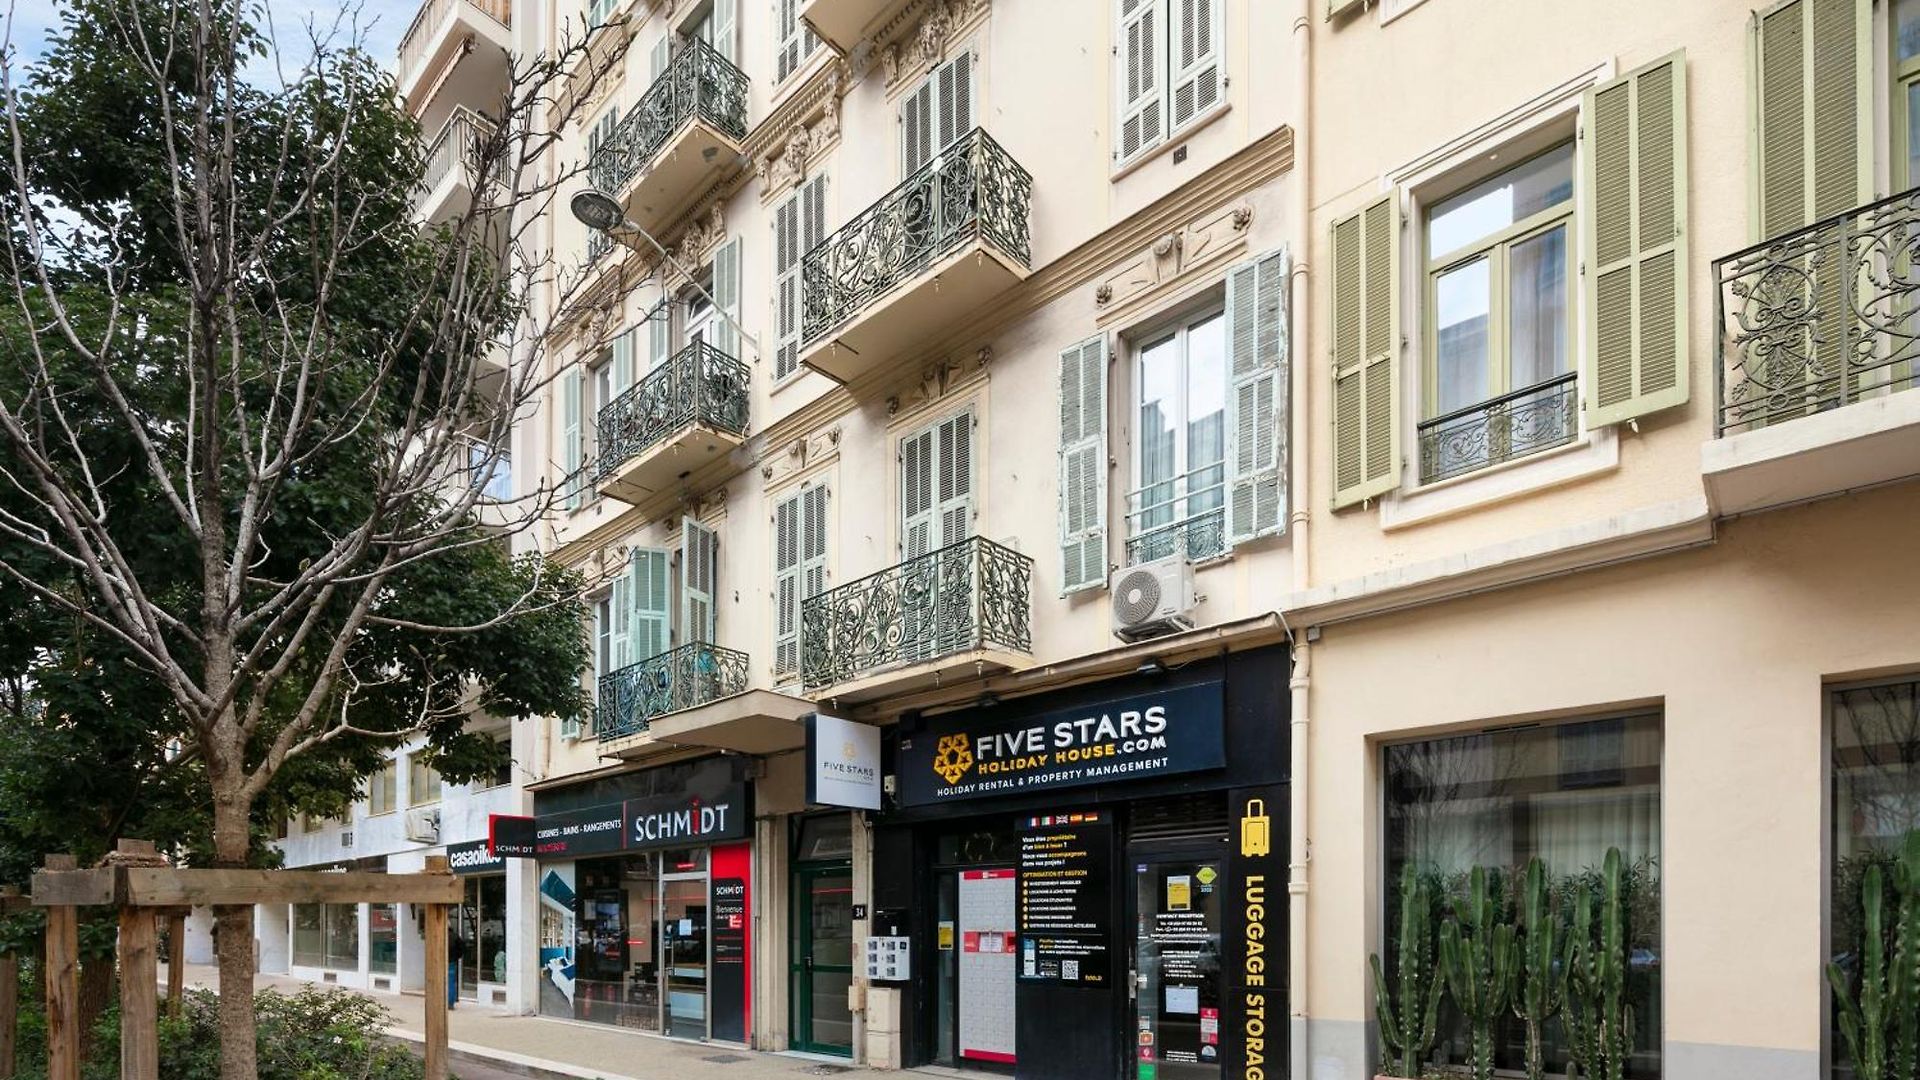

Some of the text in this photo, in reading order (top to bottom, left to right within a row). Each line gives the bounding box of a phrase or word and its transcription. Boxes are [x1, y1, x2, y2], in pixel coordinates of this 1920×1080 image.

[977, 706, 1167, 760] FIVE STARS
[823, 761, 874, 776] FIVE STARS
[978, 735, 1167, 774] HOLIDAY HOUSE.COM
[937, 757, 1168, 797] HOLIDAY RENTAL & PROPERTY MANAGEMENT
[537, 829, 559, 839] CUISINES
[563, 825, 580, 835] BAINS
[583, 819, 622, 833] RANGEMENTS
[1246, 876, 1264, 1080] LUGGAGE STORAG
